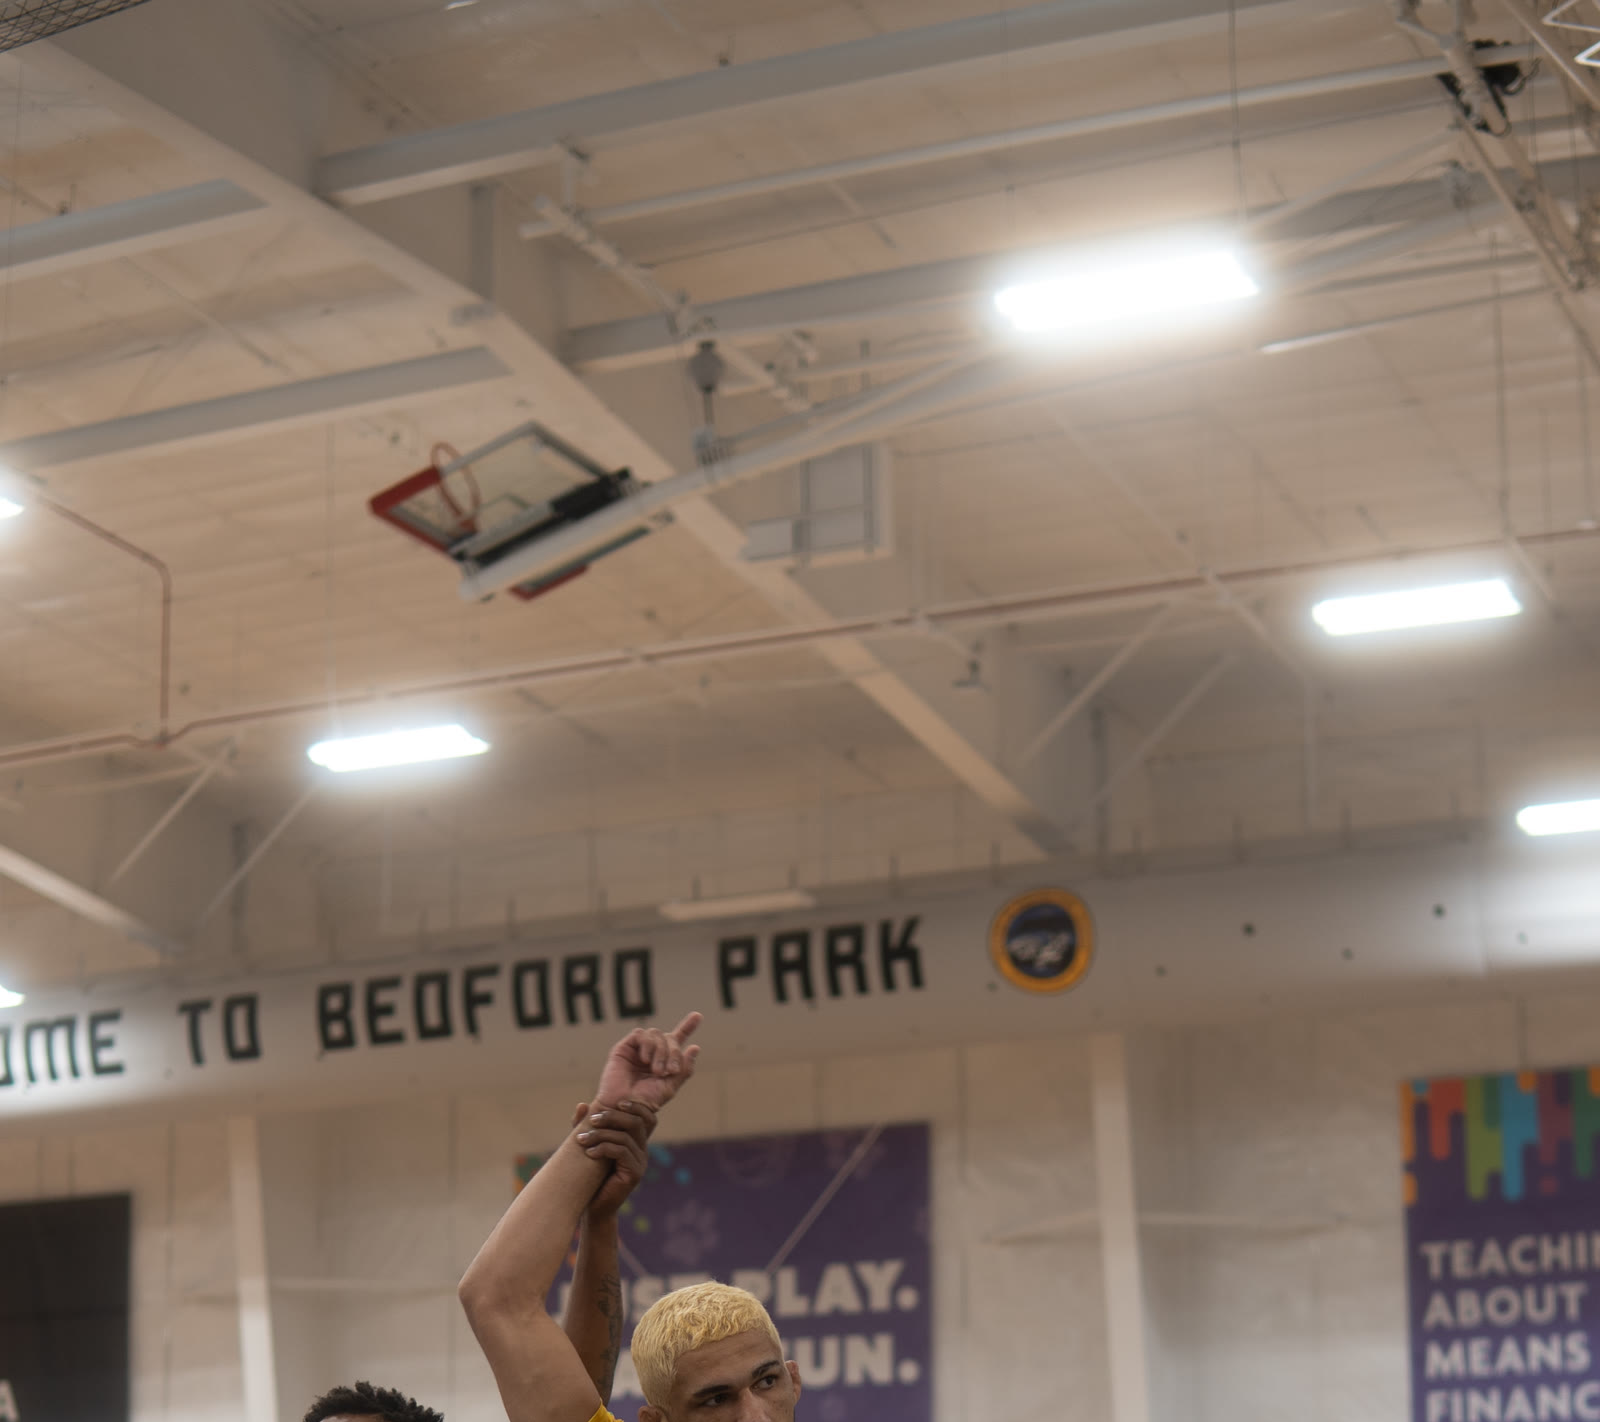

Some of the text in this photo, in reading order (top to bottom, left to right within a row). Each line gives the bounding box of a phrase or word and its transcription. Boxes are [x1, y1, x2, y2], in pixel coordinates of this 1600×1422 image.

[178, 992, 262, 1067] TO
[317, 948, 656, 1050] BEDFORD
[716, 915, 925, 1009] PARK
[1424, 1282, 1588, 1330] ABOUT
[783, 1333, 920, 1388] UN.
[1425, 1332, 1592, 1381] MEANS
